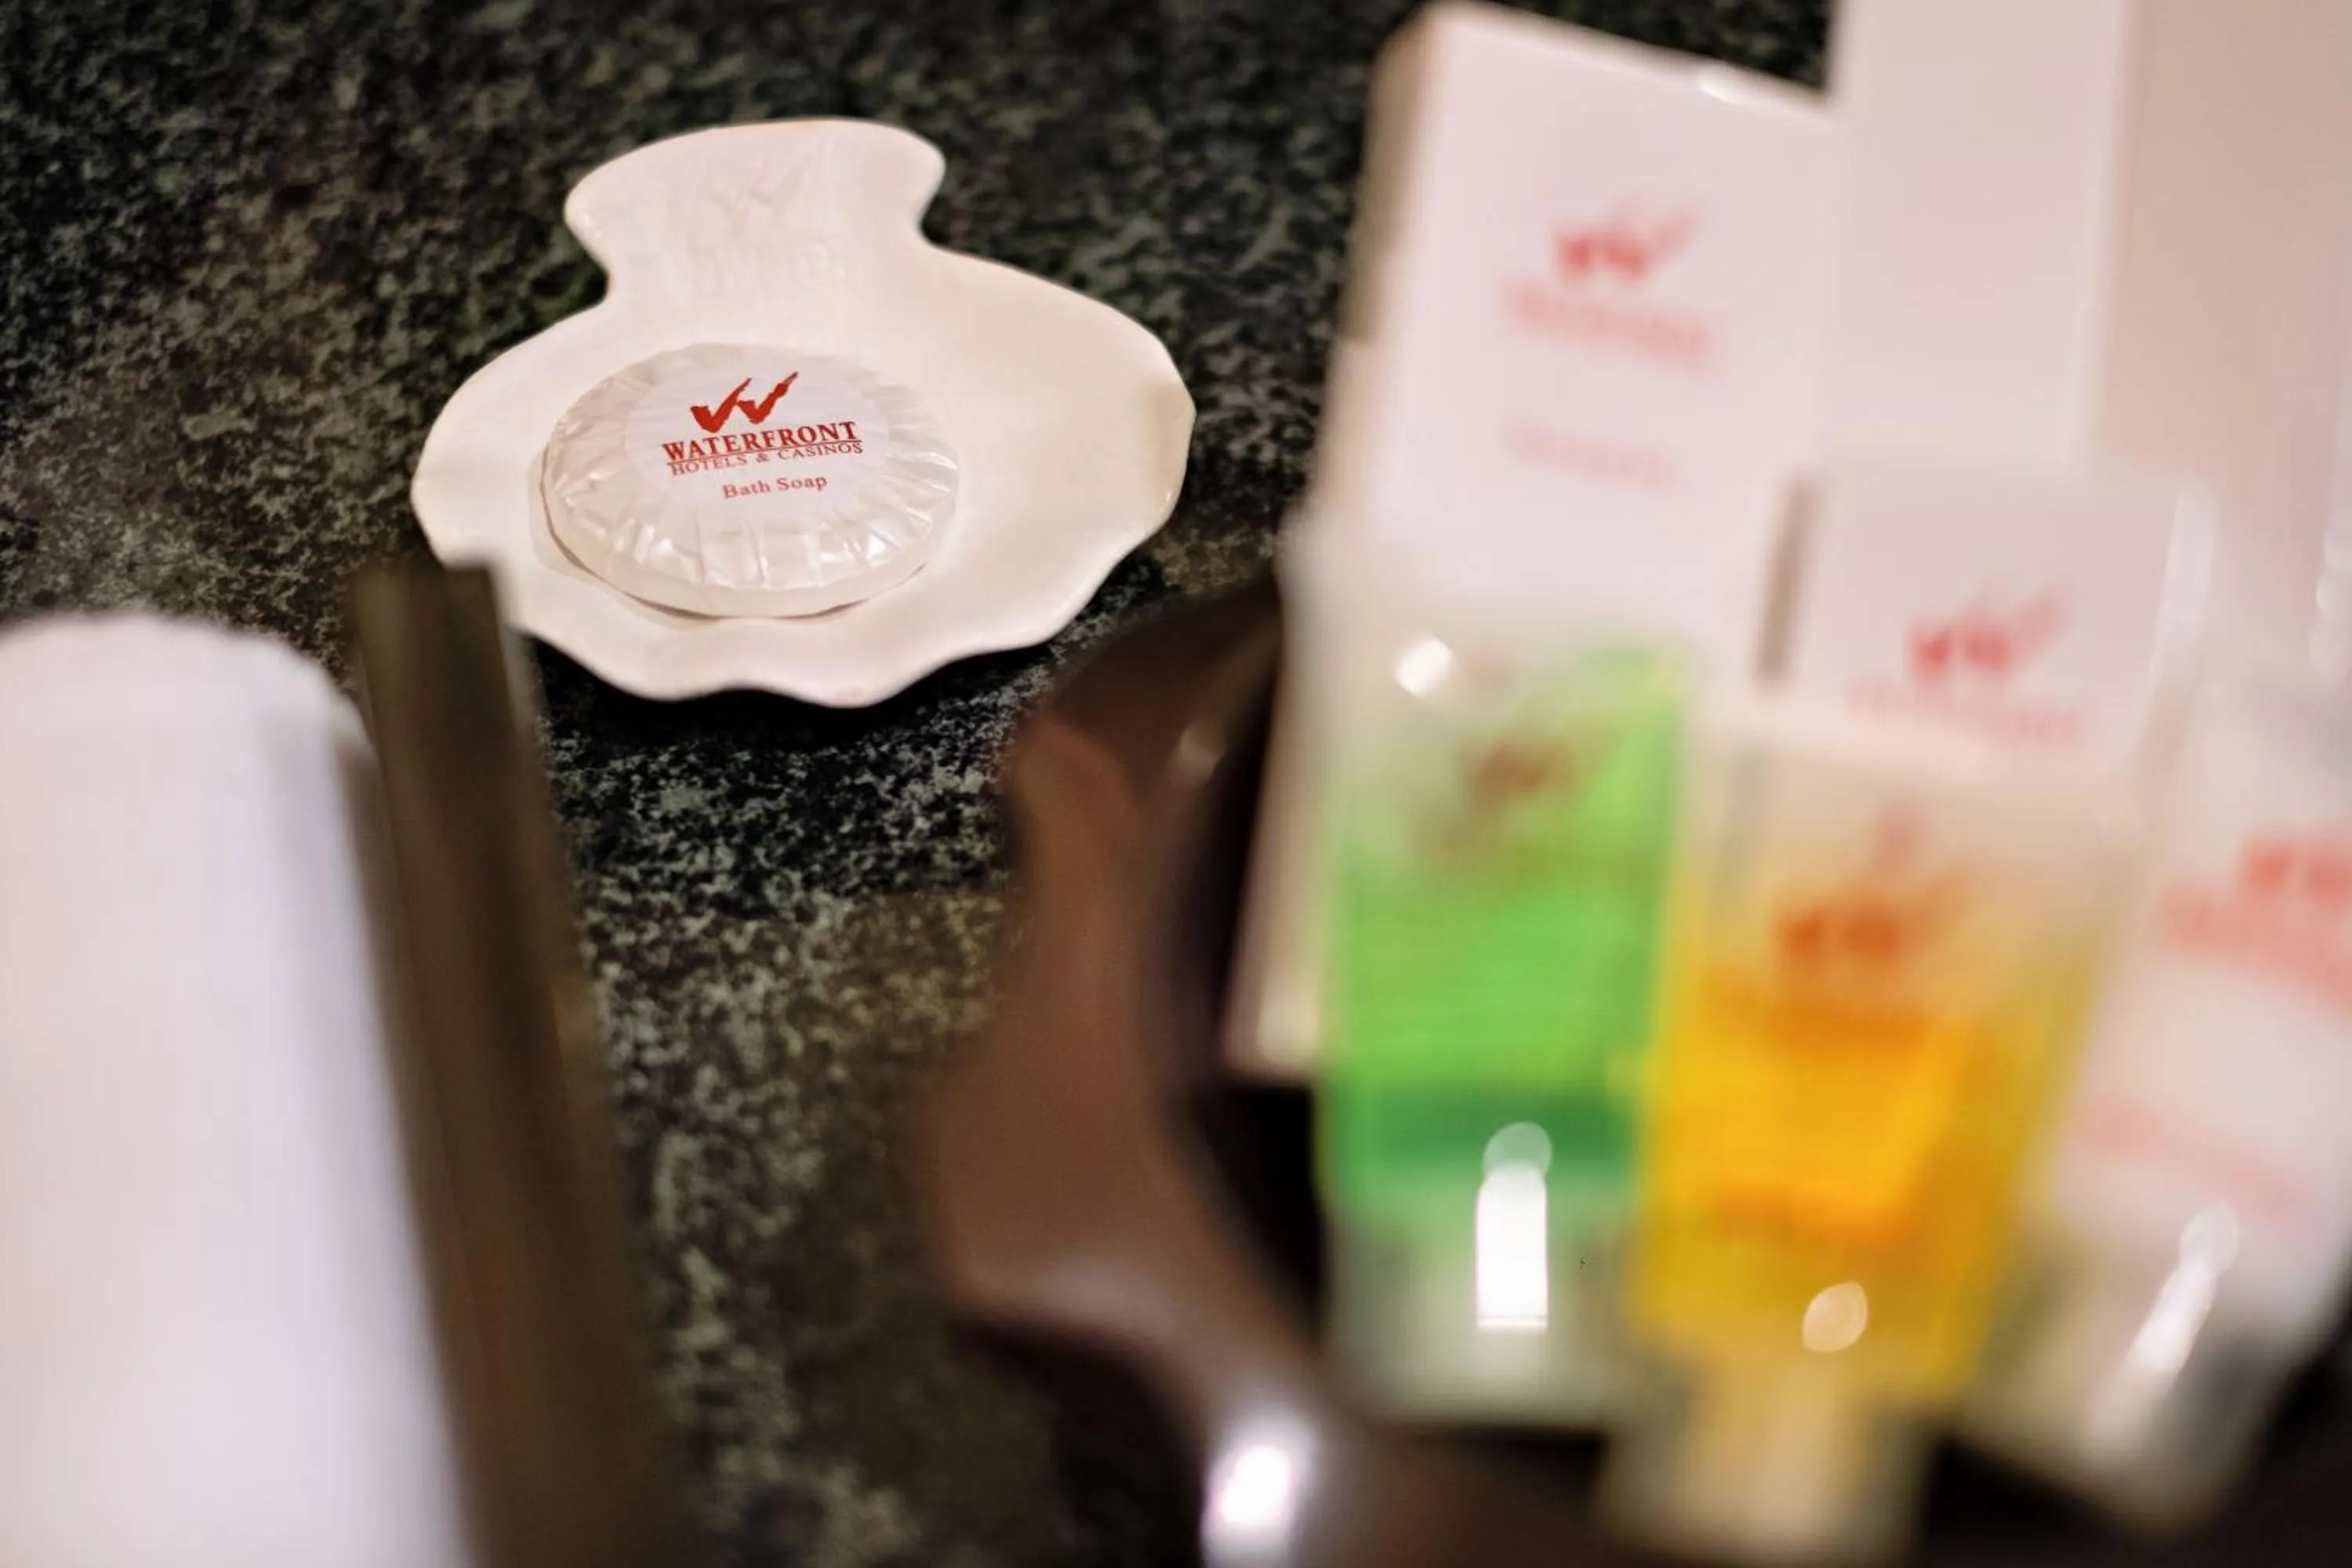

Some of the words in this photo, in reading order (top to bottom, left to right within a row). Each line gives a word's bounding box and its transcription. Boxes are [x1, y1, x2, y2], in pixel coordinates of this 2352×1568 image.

[662, 421, 858, 461] WATERFRONT
[671, 455, 747, 476] HOTELS
[756, 451, 769, 463] &
[777, 442, 863, 460] CASINOS
[723, 481, 771, 499] Bath
[778, 476, 827, 494] Soap
